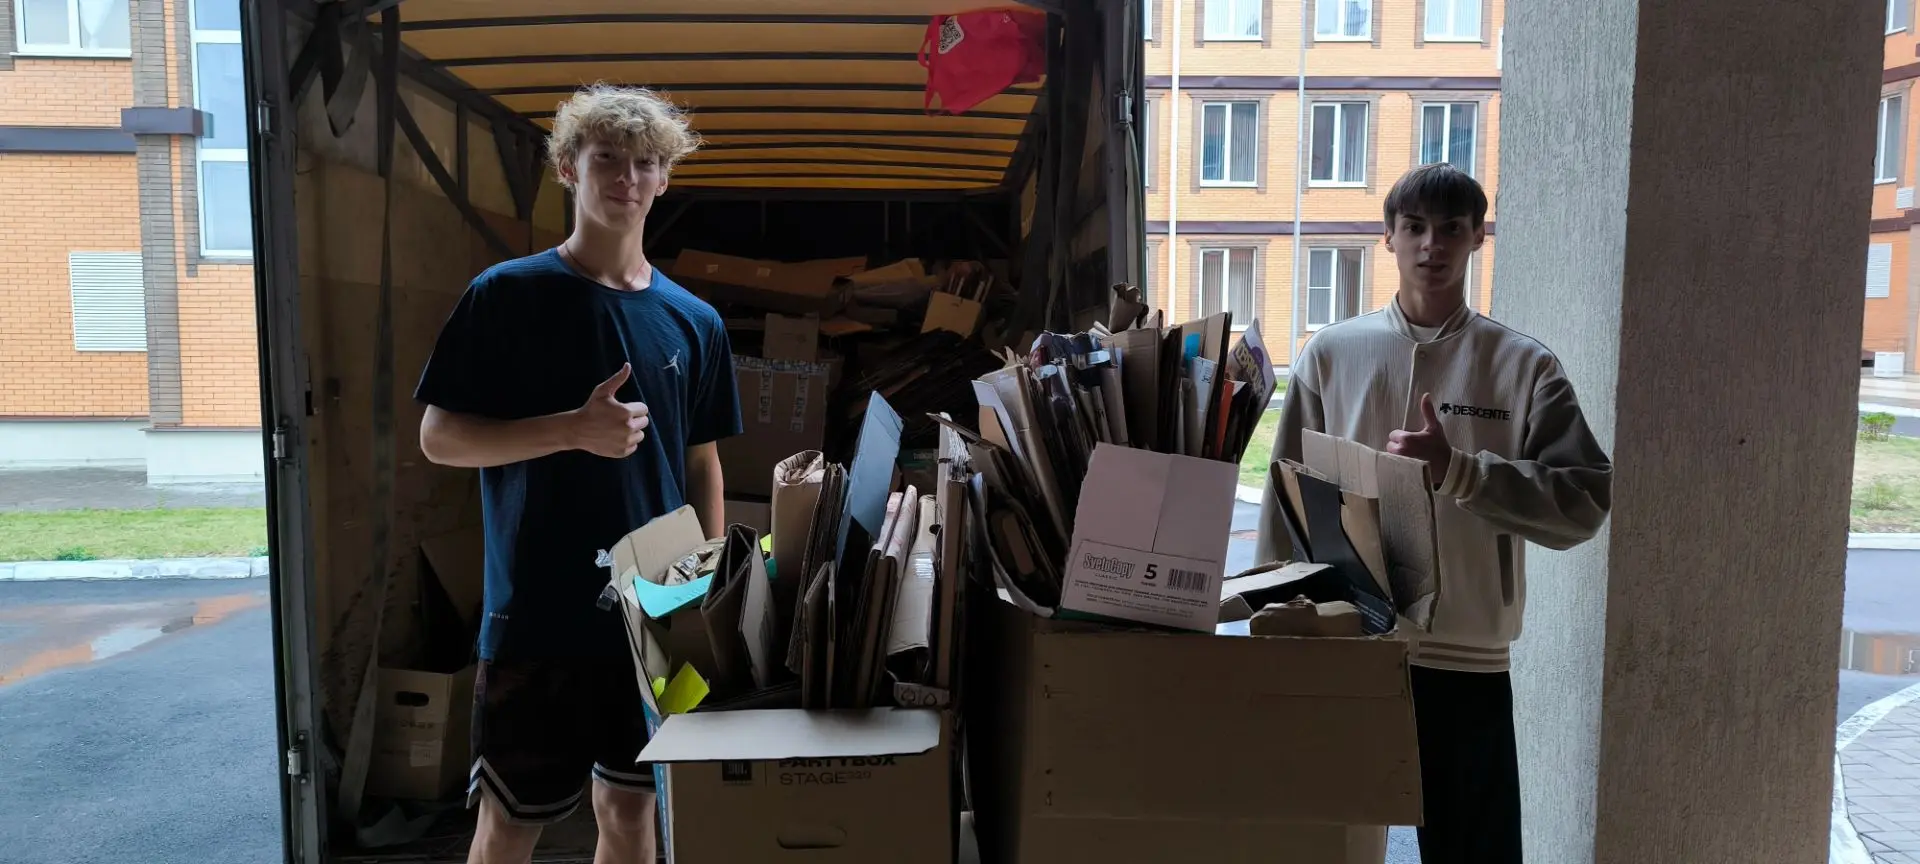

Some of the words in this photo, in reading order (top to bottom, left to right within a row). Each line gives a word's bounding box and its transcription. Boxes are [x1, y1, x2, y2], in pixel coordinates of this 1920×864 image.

[1453, 405, 1511, 421] DESCENTE
[1083, 553, 1135, 579] SvetoCopy
[1144, 563, 1158, 580] 5
